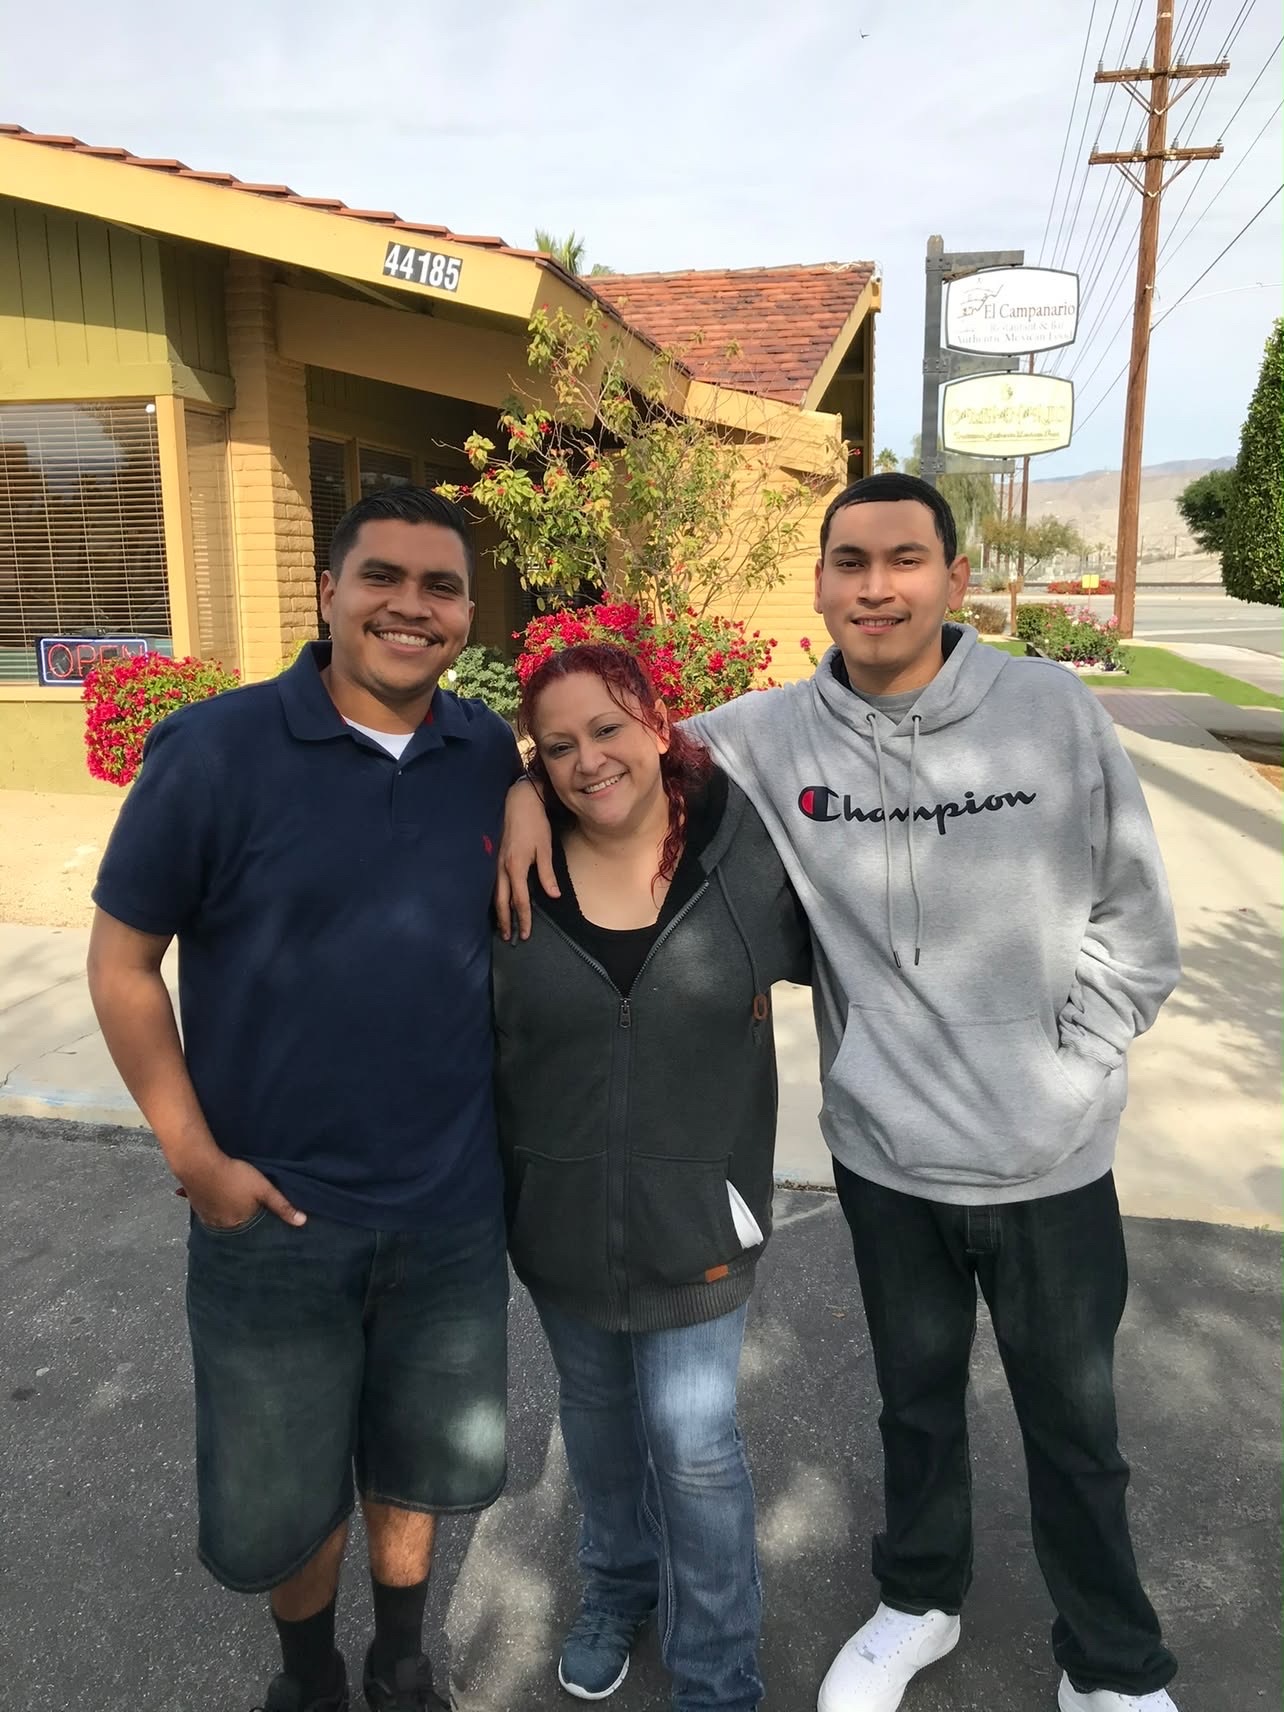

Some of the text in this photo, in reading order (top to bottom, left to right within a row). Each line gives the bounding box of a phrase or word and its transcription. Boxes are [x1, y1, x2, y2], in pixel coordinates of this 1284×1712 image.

[384, 244, 461, 290] 44185
[984, 301, 1076, 322] El Campanario
[798, 785, 1037, 836] Champion
